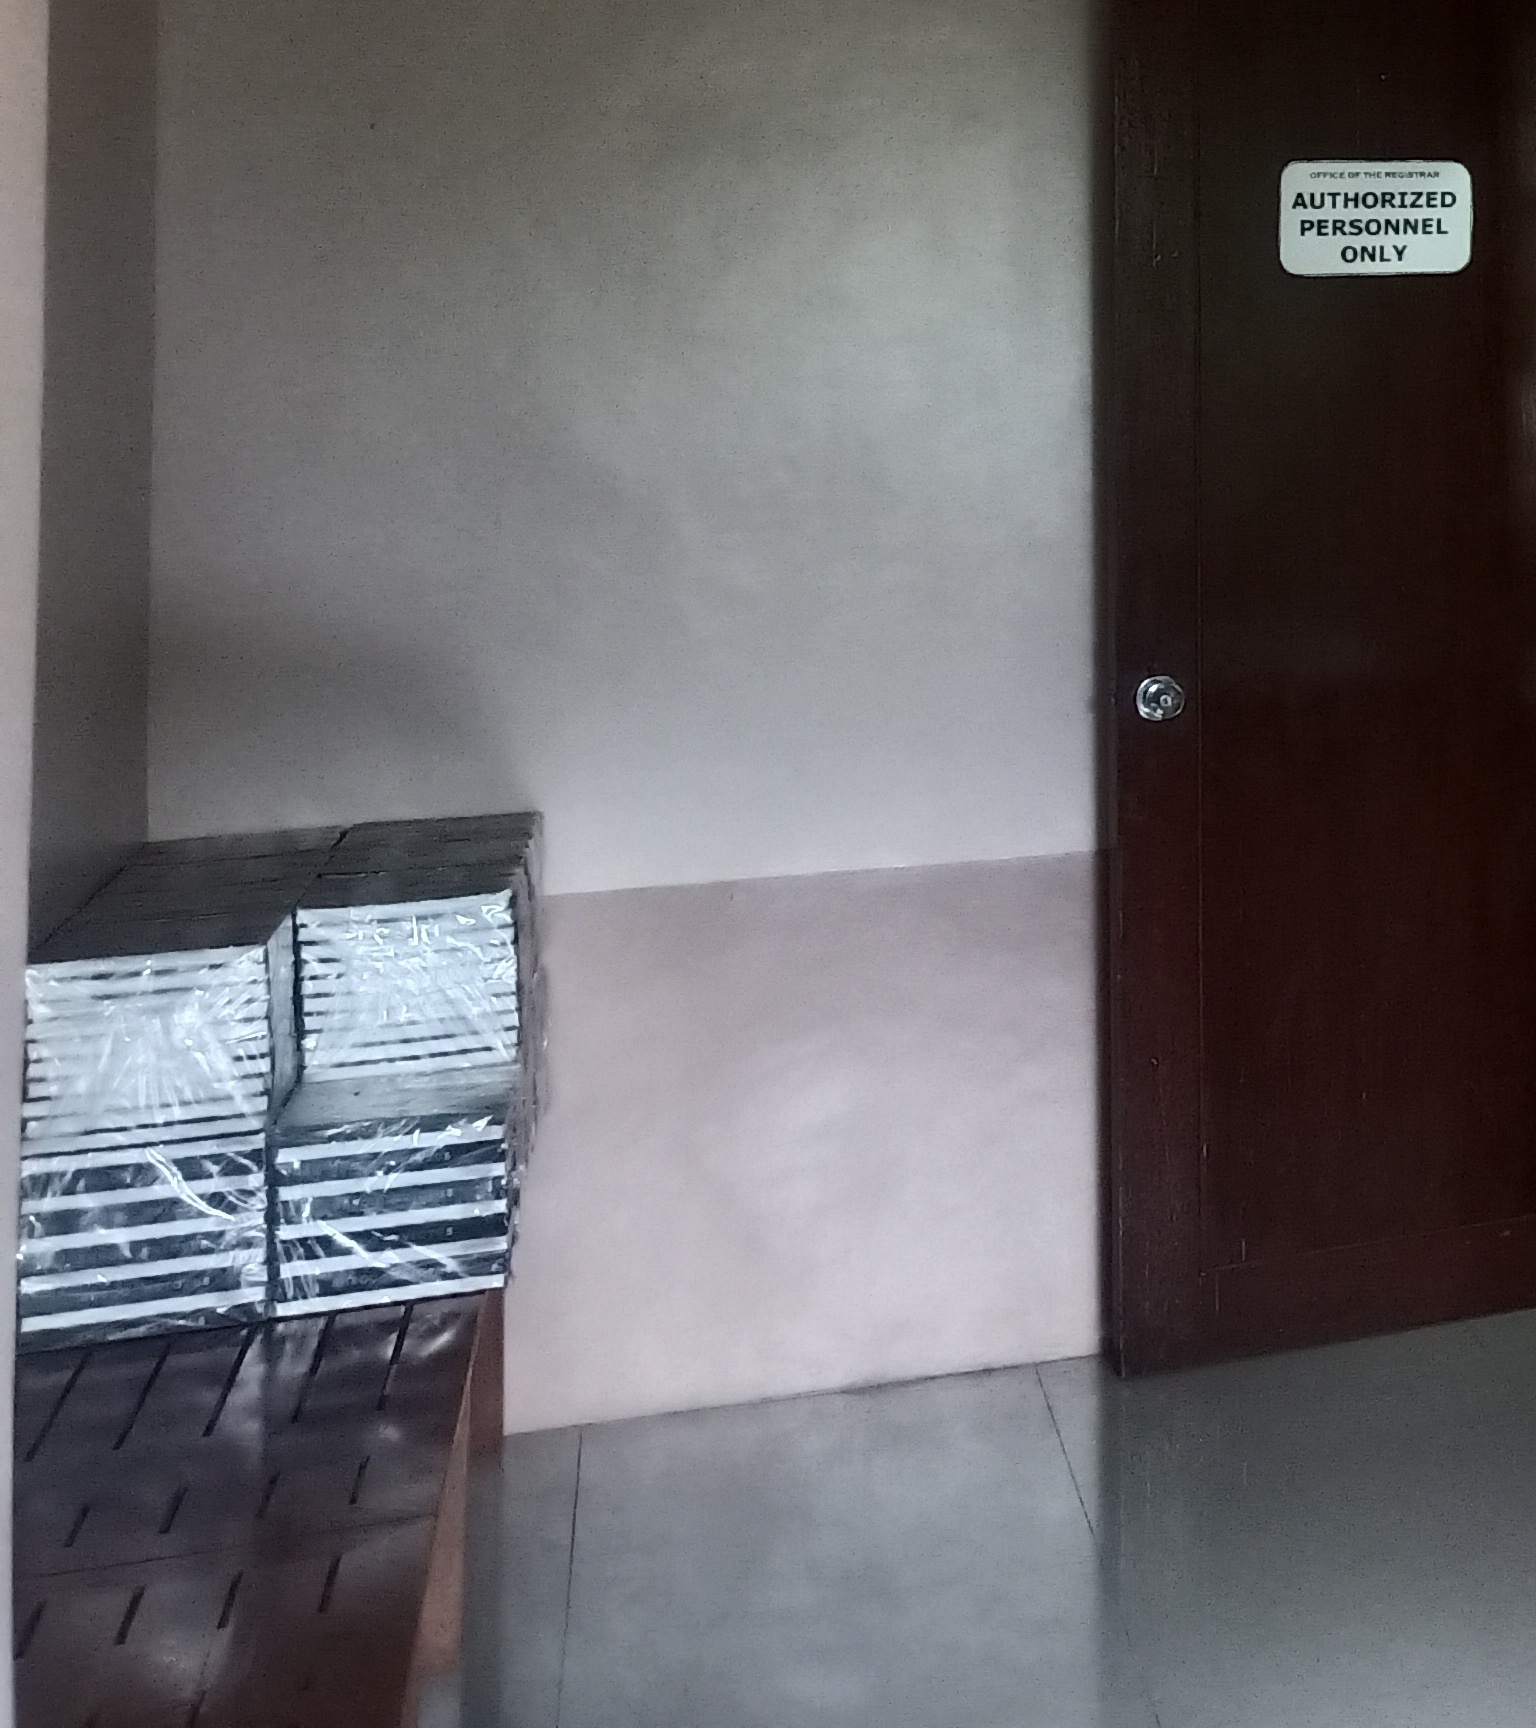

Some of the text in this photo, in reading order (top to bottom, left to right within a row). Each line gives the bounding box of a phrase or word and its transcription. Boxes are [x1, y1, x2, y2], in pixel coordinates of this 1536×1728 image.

[1309, 170, 1440, 179] OFFICE OF THE REGISTRAR
[1291, 191, 1457, 210] AUTHORIZED
[1300, 218, 1449, 236] PERSONNEL
[1340, 245, 1407, 263] ONLY
